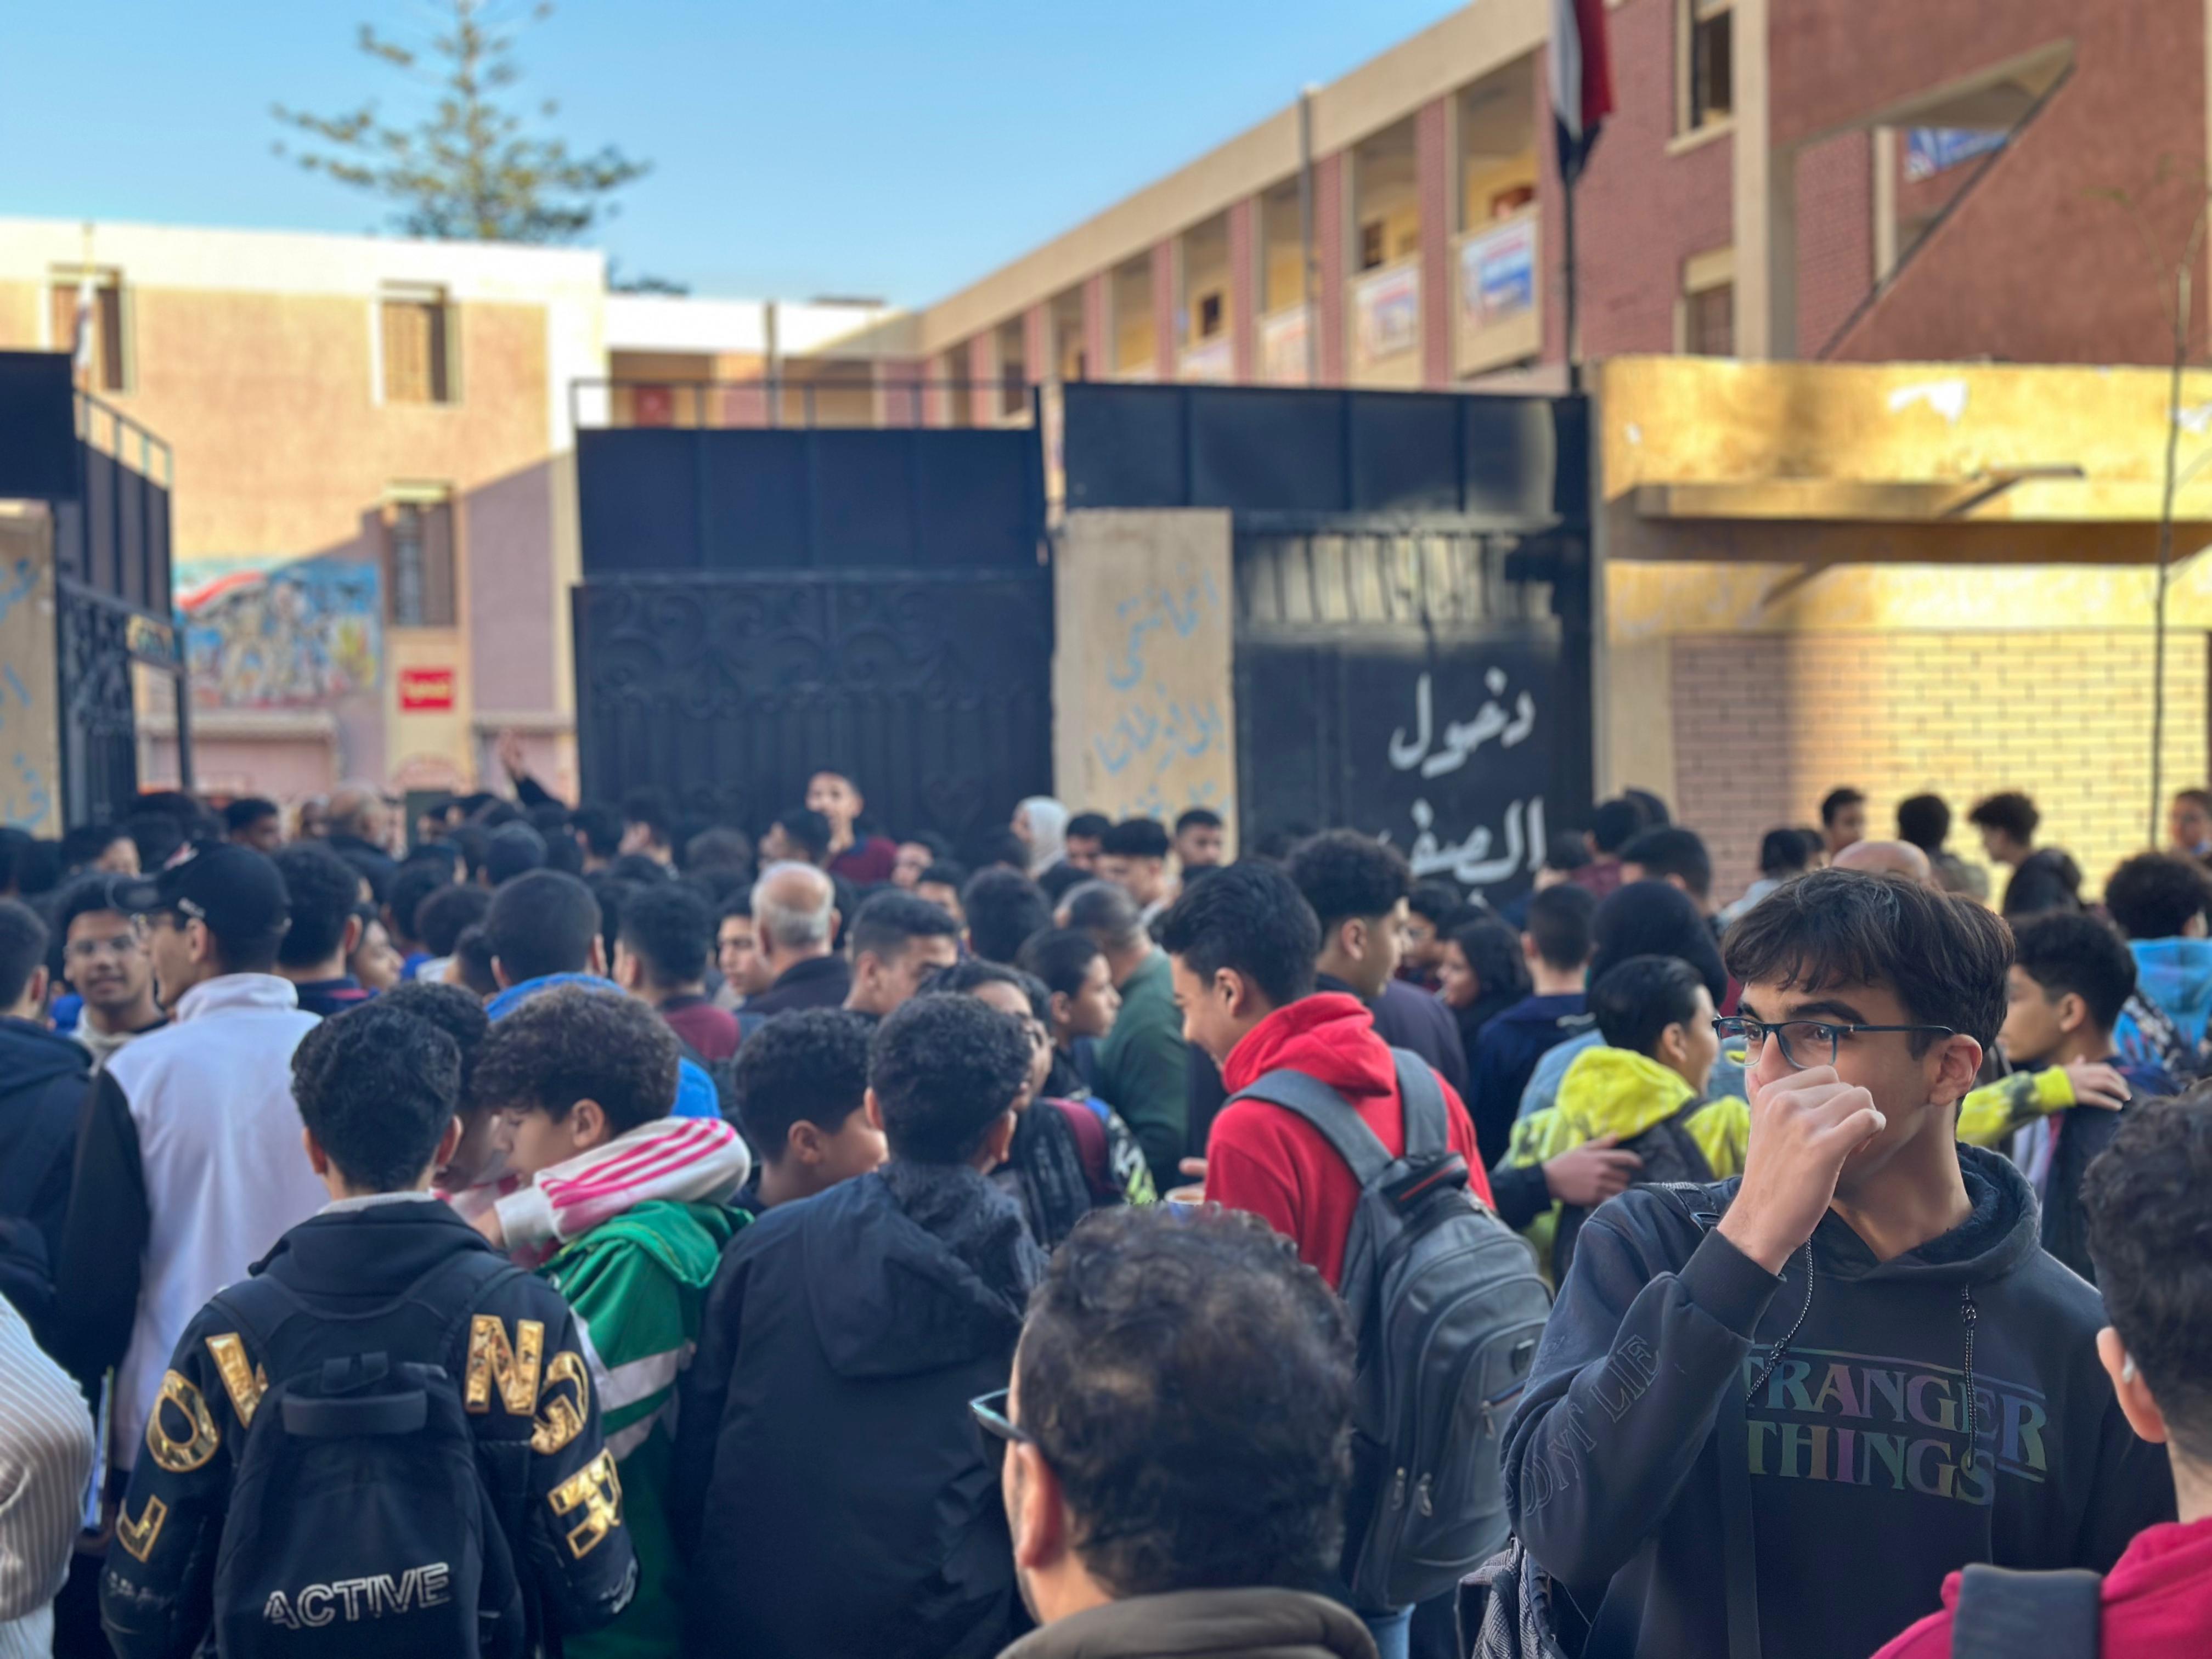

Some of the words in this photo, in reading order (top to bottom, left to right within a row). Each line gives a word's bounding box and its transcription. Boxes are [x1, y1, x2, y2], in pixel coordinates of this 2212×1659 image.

[1389, 665, 1536, 779] دخول
[1590, 1333, 1664, 1425] LIE
[1744, 1356, 2048, 1471] TRANGER
[1747, 1419, 1996, 1506] THINGS
[264, 1561, 450, 1629] ACTIVE
